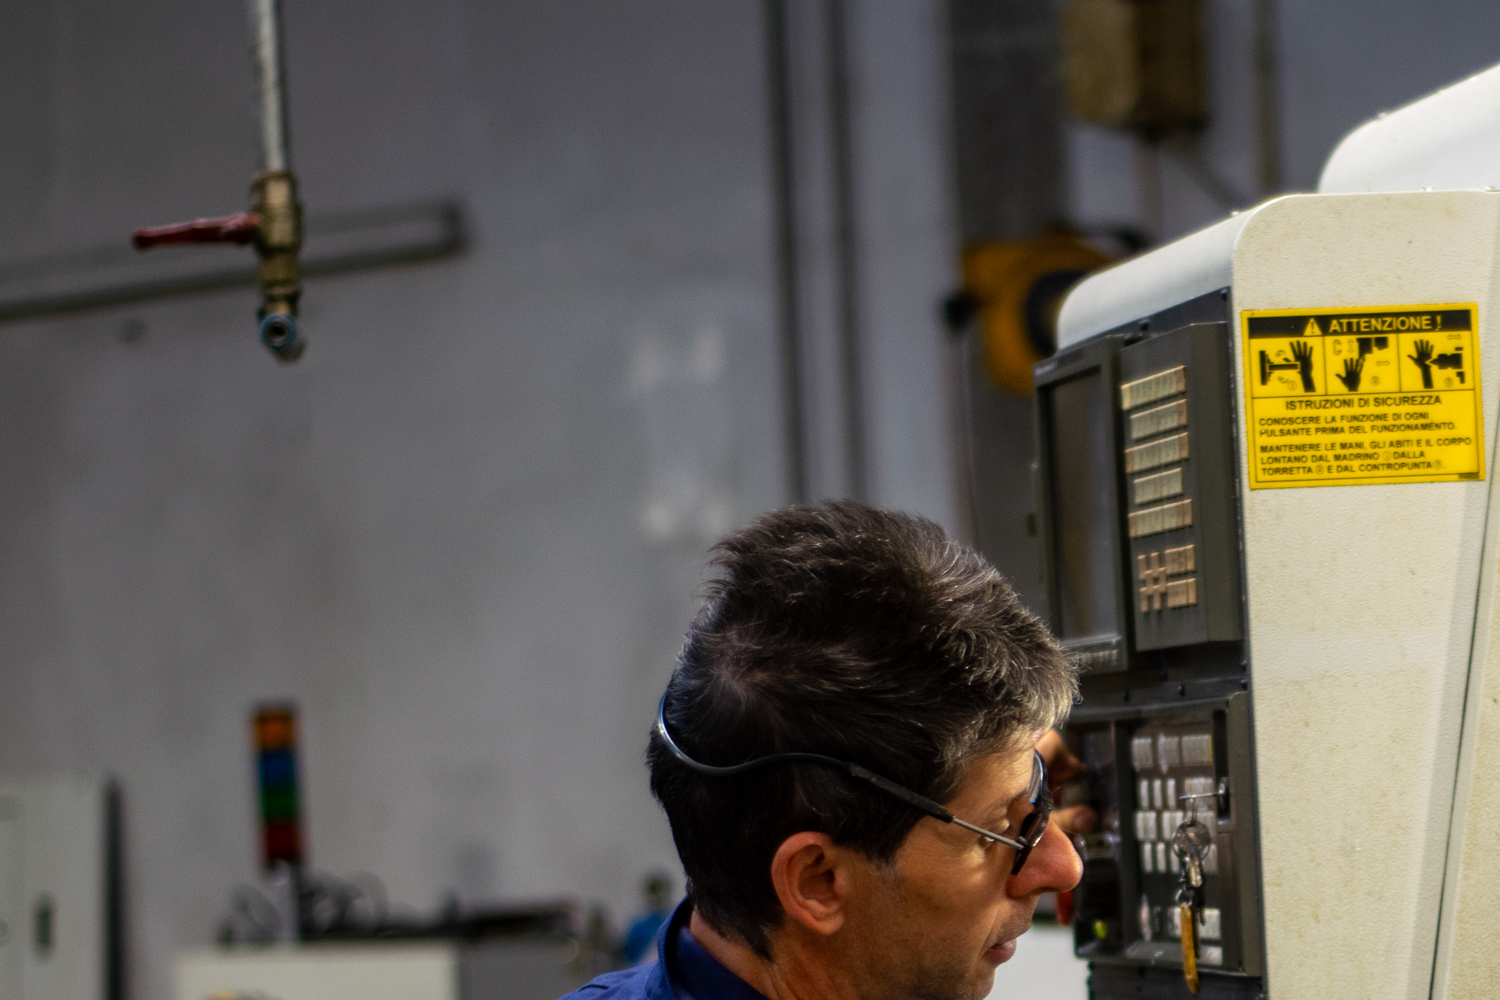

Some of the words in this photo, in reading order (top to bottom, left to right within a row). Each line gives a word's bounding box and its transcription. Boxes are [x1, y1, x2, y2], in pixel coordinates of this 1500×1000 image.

[1329, 315, 1432, 333] ATTENZIONE
[1285, 399, 1354, 410] ISTRUZIONI
[1358, 398, 1369, 408] DI
[1373, 395, 1442, 407] SICUREZZA
[1259, 416, 1322, 426] CONOSCERE
[1324, 416, 1337, 424] LA
[1340, 413, 1389, 423] FUNZIONE
[1392, 413, 1401, 421] DI
[1404, 412, 1429, 421] OGNI
[1260, 427, 1312, 437] PULSANTE
[1315, 427, 1345, 435] PRIMA
[1349, 426, 1368, 434] DEL
[1260, 443, 1322, 453] MANTENERE
[1324, 443, 1337, 451] LE
[1370, 441, 1386, 449] GLI
[1388, 440, 1414, 448] ABITI
[1416, 439, 1422, 447] E
[1425, 439, 1433, 447] IL
[1436, 437, 1472, 447] CORPO
[1261, 455, 1308, 465] LONTANO
[1311, 455, 1330, 463] DAL
[1333, 452, 1380, 462] MADRINO
[1393, 451, 1425, 459] DALLA
[1261, 466, 1313, 476] TORRETTA
[1327, 465, 1333, 473] E
[1336, 465, 1356, 473] DAL
[1359, 461, 1432, 472] CONTROPUNTA
